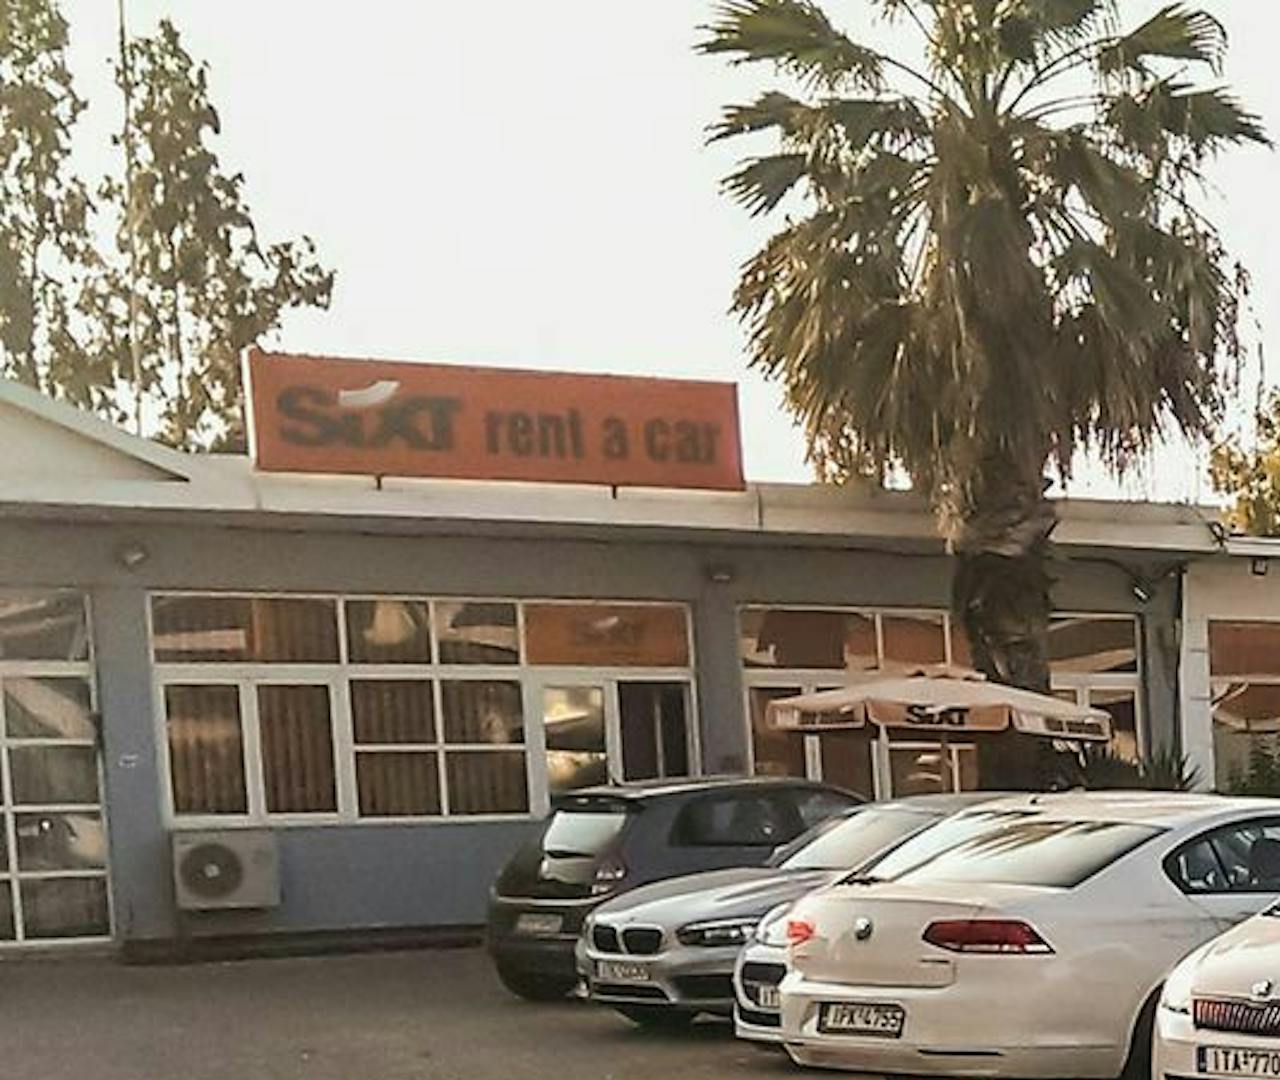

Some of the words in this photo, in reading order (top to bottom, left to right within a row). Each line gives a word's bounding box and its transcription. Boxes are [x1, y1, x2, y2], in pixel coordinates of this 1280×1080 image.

[484, 407, 586, 461] rent
[602, 414, 629, 460] a
[643, 416, 722, 465] car
